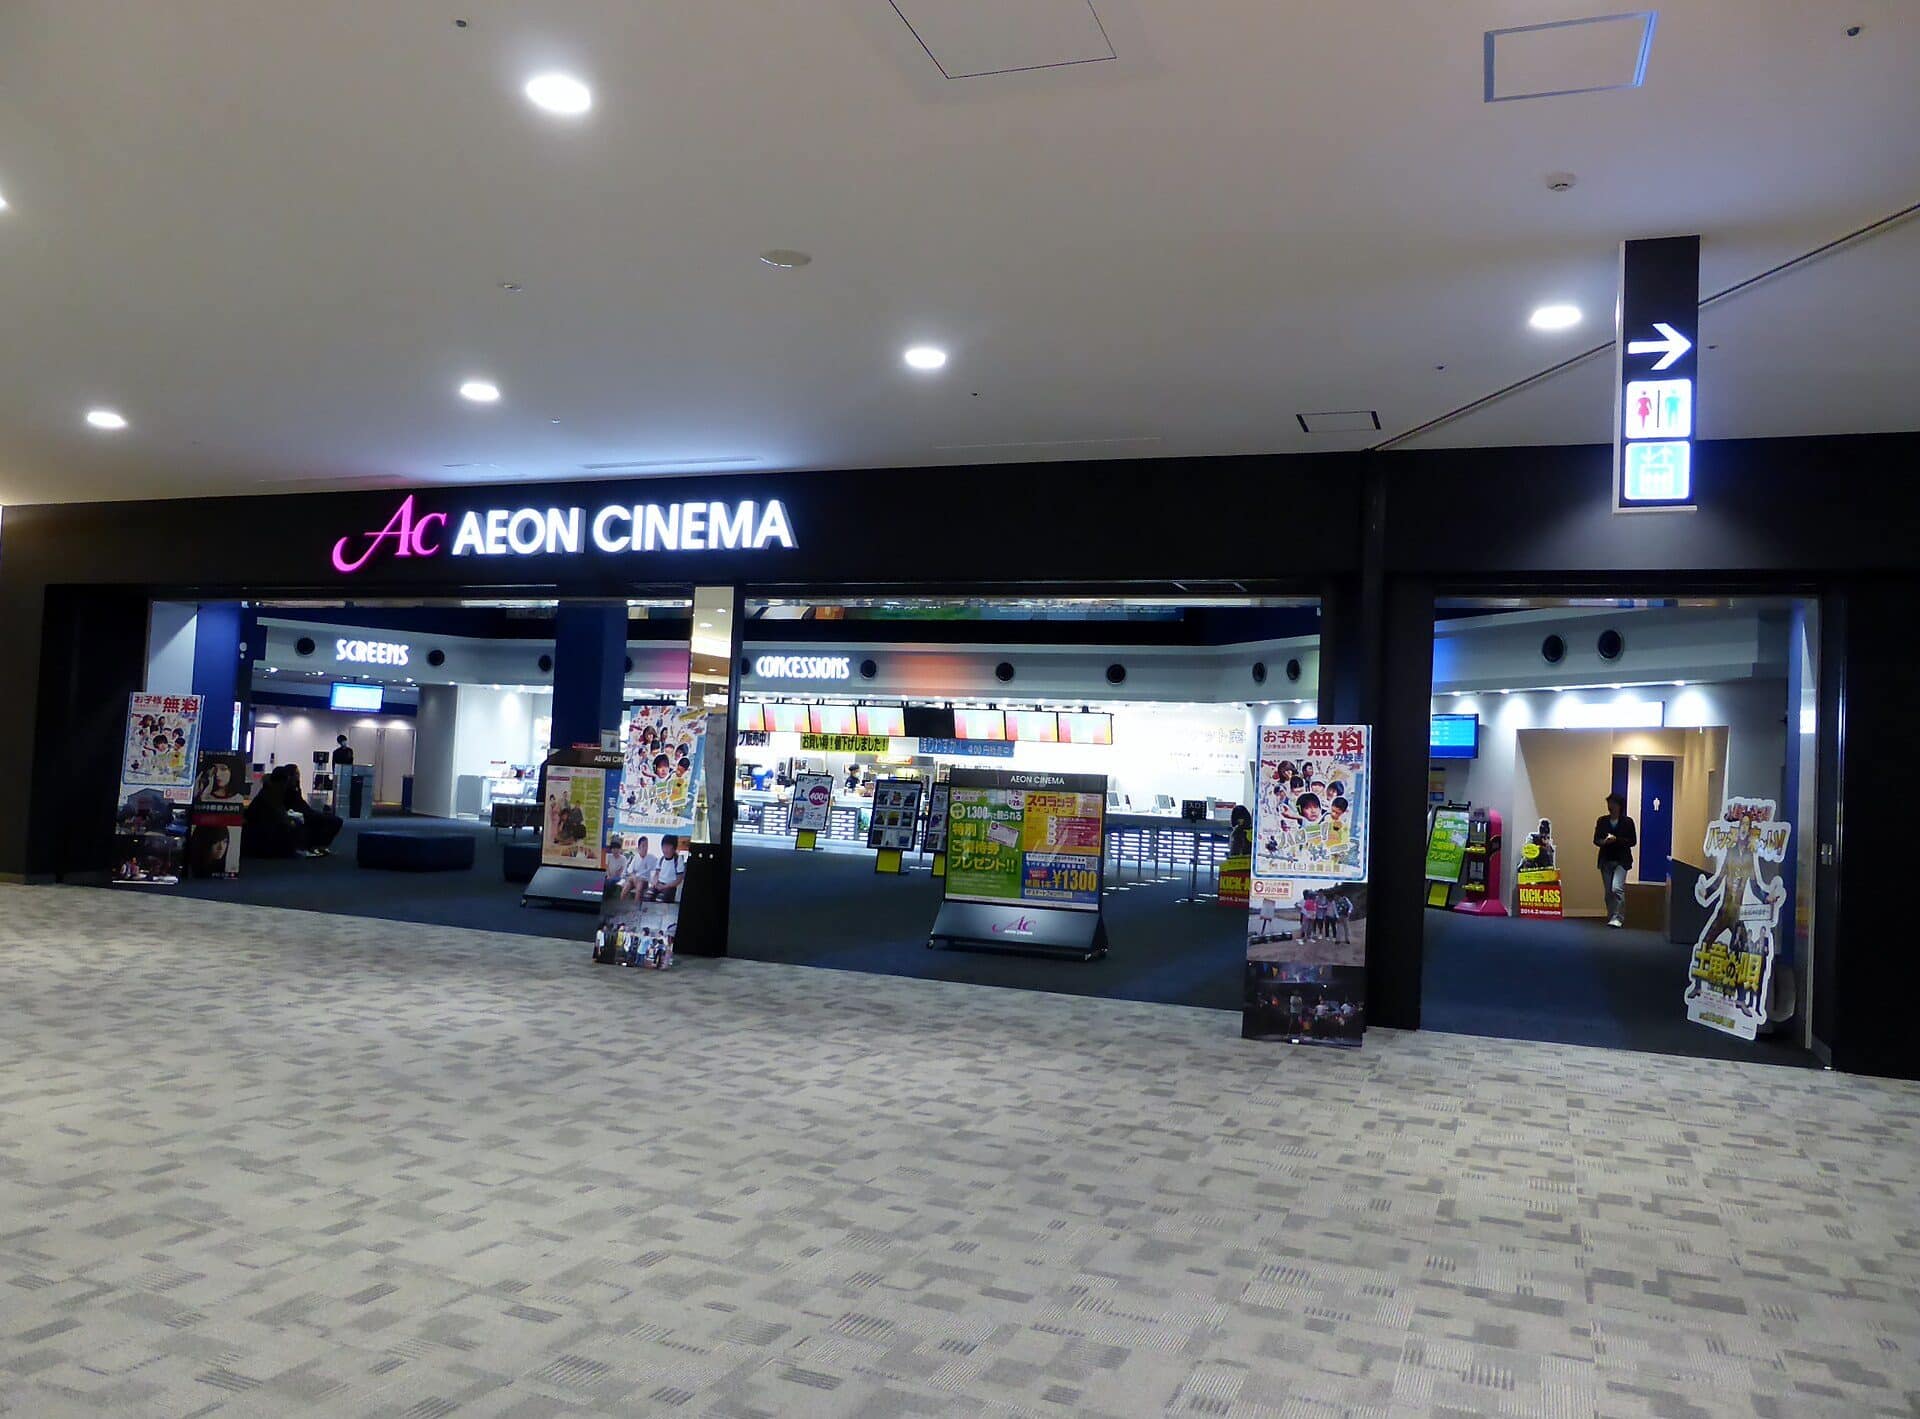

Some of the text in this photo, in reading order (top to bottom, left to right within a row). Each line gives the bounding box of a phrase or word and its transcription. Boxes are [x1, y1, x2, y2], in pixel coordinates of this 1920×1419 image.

[452, 507, 582, 556] AEON
[593, 500, 795, 553] CINEMA
[336, 639, 410, 665] SCREENS
[756, 655, 850, 680] CONCESSIONS
[1263, 729, 1365, 757] お子様 無料
[1010, 775, 1065, 785] AEON CINEMA
[1053, 868, 1098, 892] ¥1300
[1519, 888, 1561, 904] KICK-ASS
